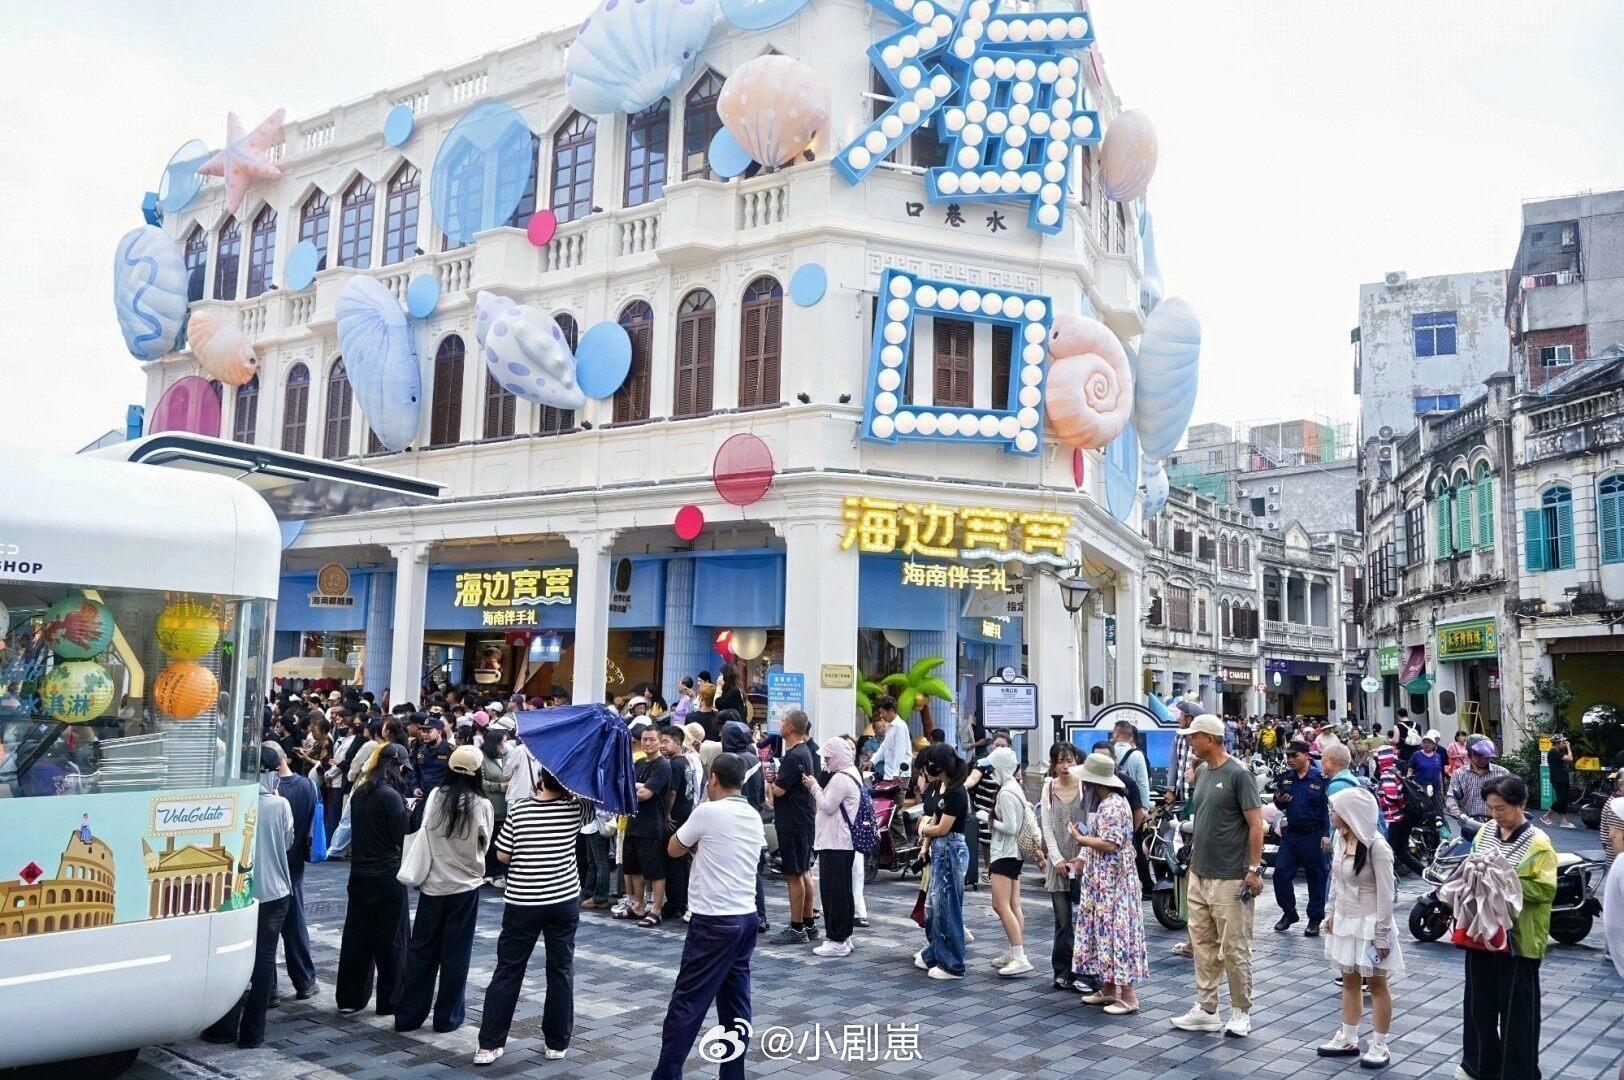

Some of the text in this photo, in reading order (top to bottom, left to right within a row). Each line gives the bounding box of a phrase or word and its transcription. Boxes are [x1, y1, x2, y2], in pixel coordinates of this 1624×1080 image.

[0, 560, 43, 574] HOP
[902, 562, 1011, 592] 海南伴手礼
[482, 610, 538, 625] 海南伴手礼
[157, 804, 232, 824] VolaGelato
